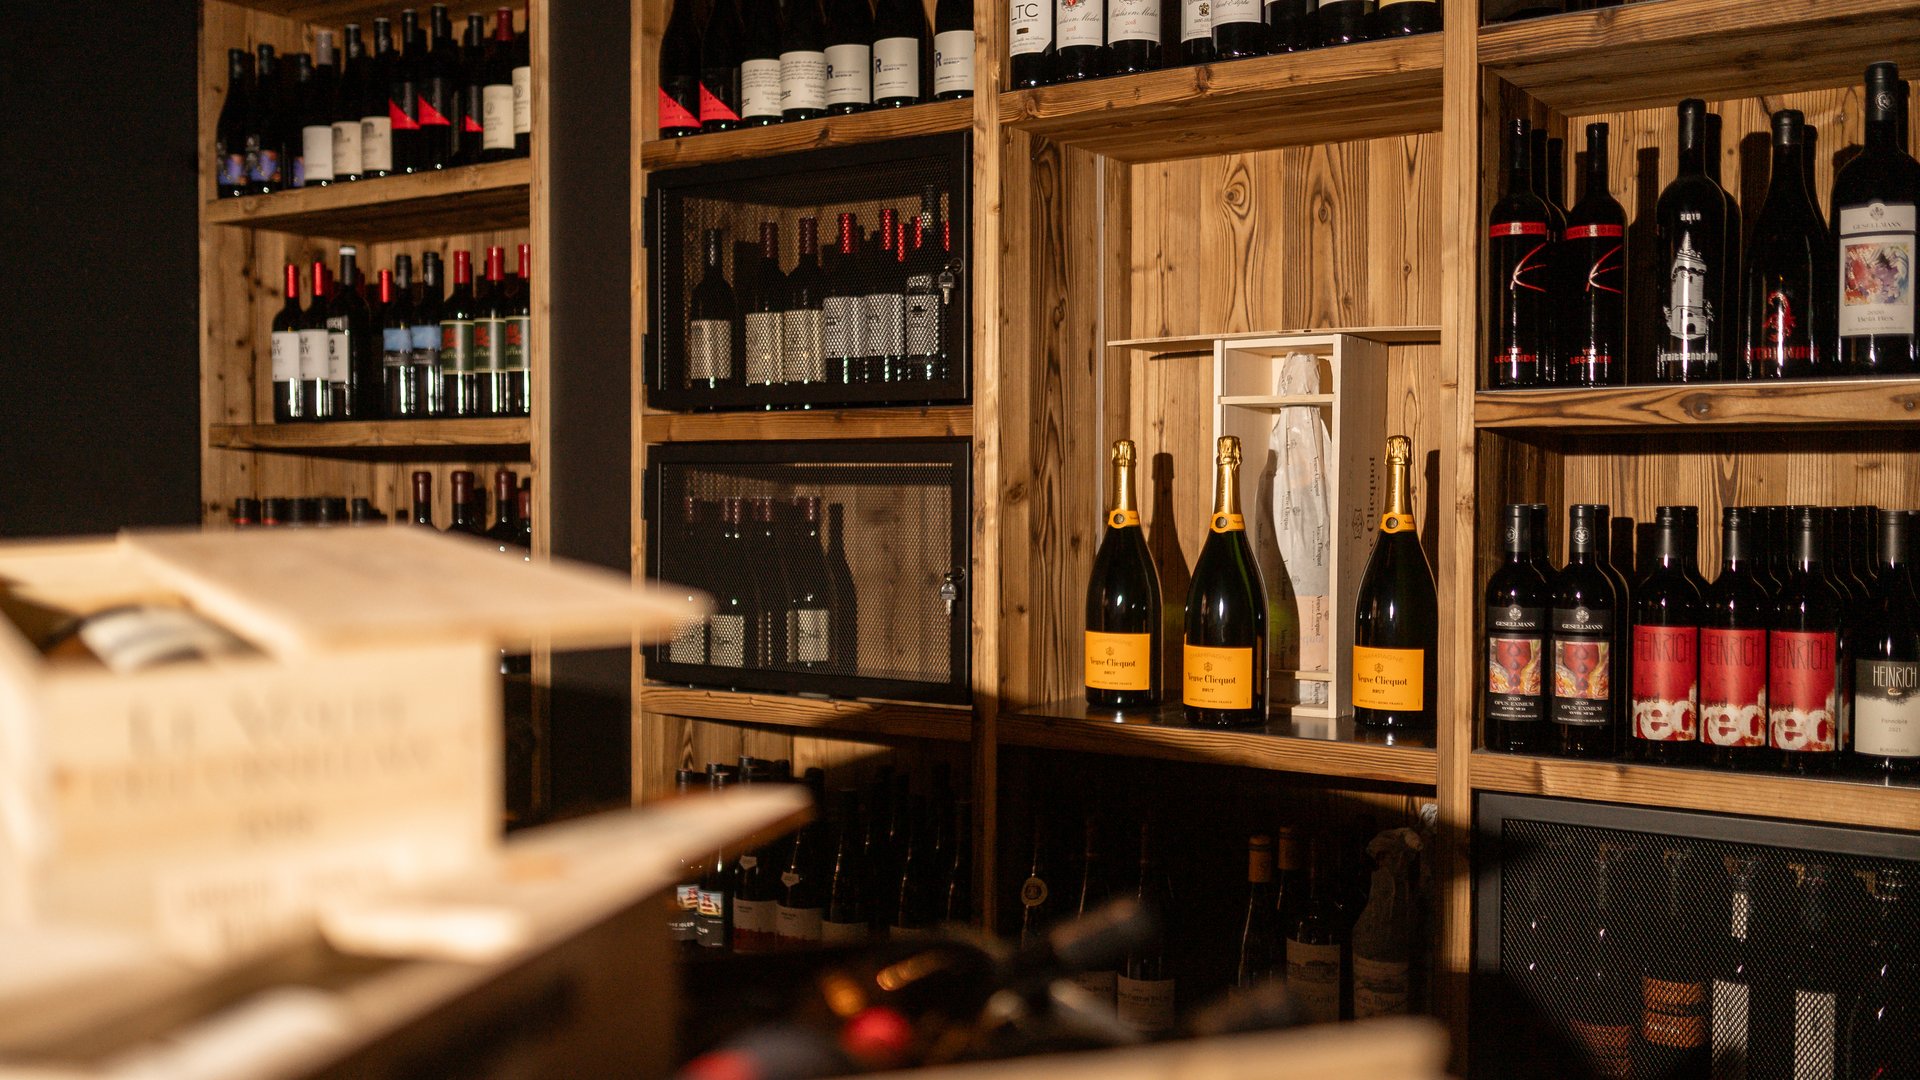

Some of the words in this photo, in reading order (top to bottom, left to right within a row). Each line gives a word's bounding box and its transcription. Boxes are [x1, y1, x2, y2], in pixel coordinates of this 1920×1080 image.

[1011, 3, 1039, 21] LTC
[1680, 212, 1702, 221] 2019
[1494, 354, 1537, 364] LEGENDS
[1569, 355, 1613, 365] LEGENDS
[1366, 456, 1376, 533] Clicquot
[1495, 620, 1536, 628] GESELLMANN
[1562, 623, 1604, 631] GESELLMANN
[1090, 656, 1105, 666] Veuve
[1106, 658, 1136, 669] Clicquot
[1187, 671, 1203, 682] Veuve
[1204, 674, 1236, 686] Clicquot
[1357, 672, 1374, 684] Veuve
[1375, 675, 1408, 687] Clicquot
[1873, 665, 1918, 688] HEINRICH
